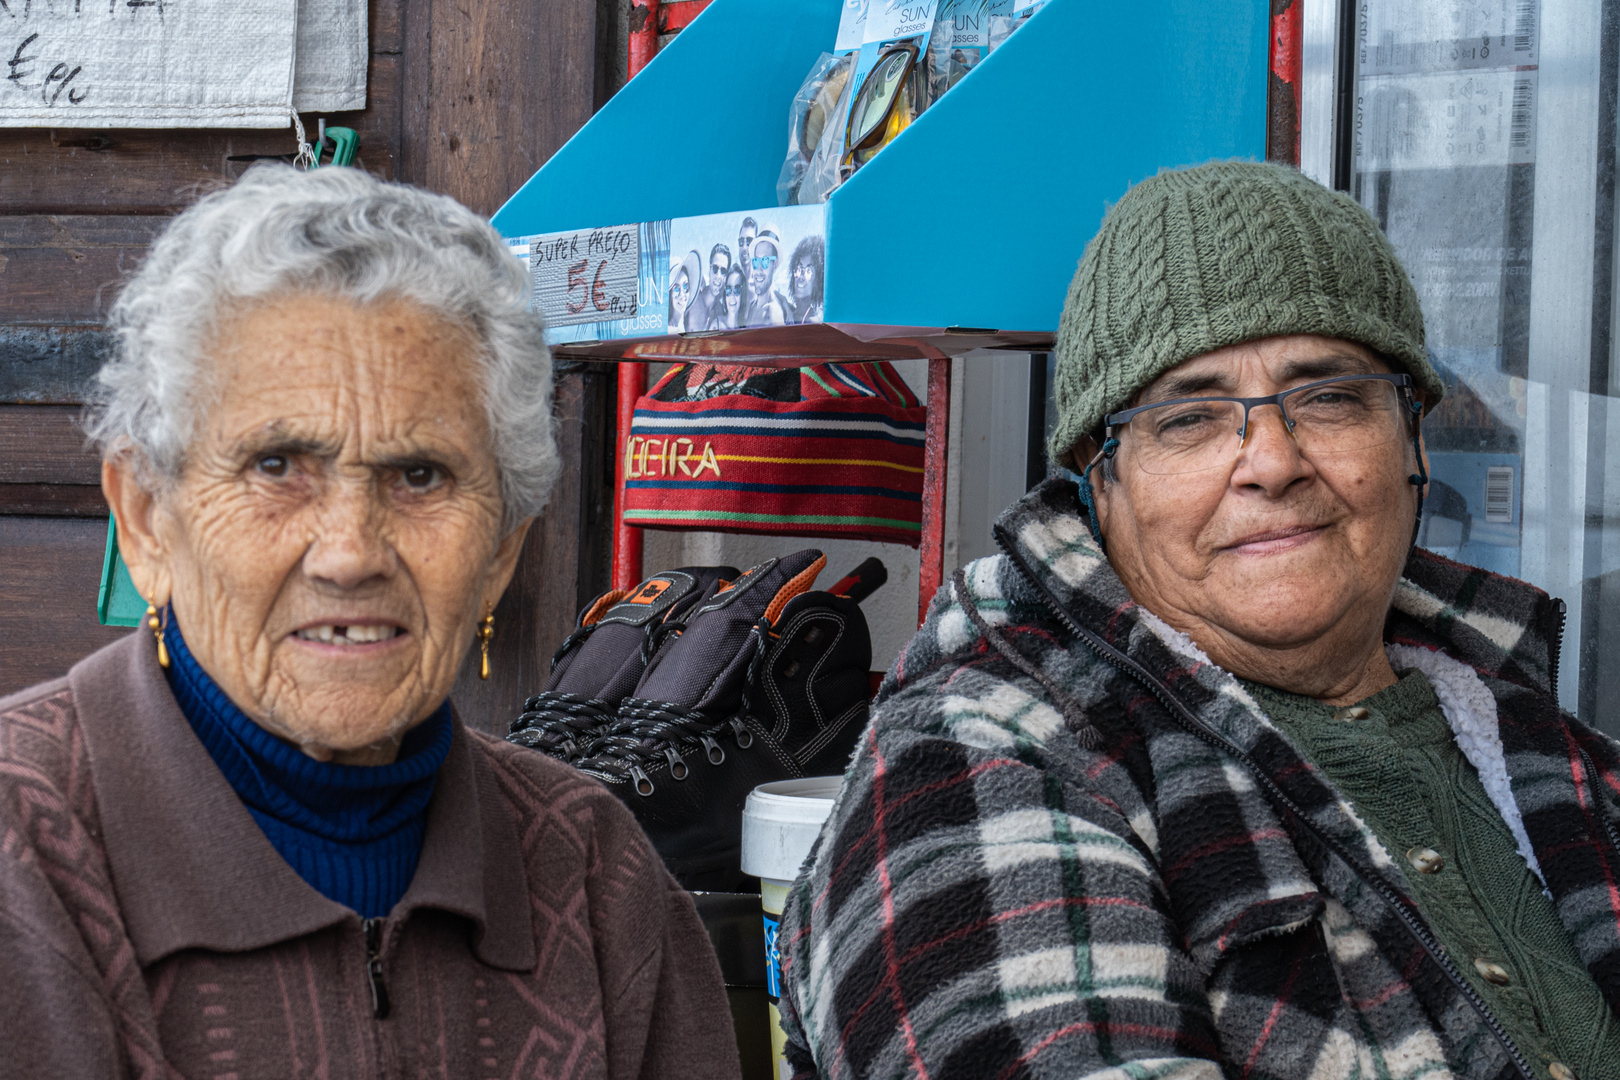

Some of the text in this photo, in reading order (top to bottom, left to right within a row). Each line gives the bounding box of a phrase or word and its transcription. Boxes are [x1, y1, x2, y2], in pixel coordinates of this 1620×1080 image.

[900, 5, 931, 23] SUN
[953, 15, 979, 31] UN
[893, 22, 926, 37] glasses
[952, 34, 980, 43] asses
[536, 231, 631, 267] SUPER PREÇO
[566, 259, 610, 315] 5€
[636, 275, 664, 307] UN
